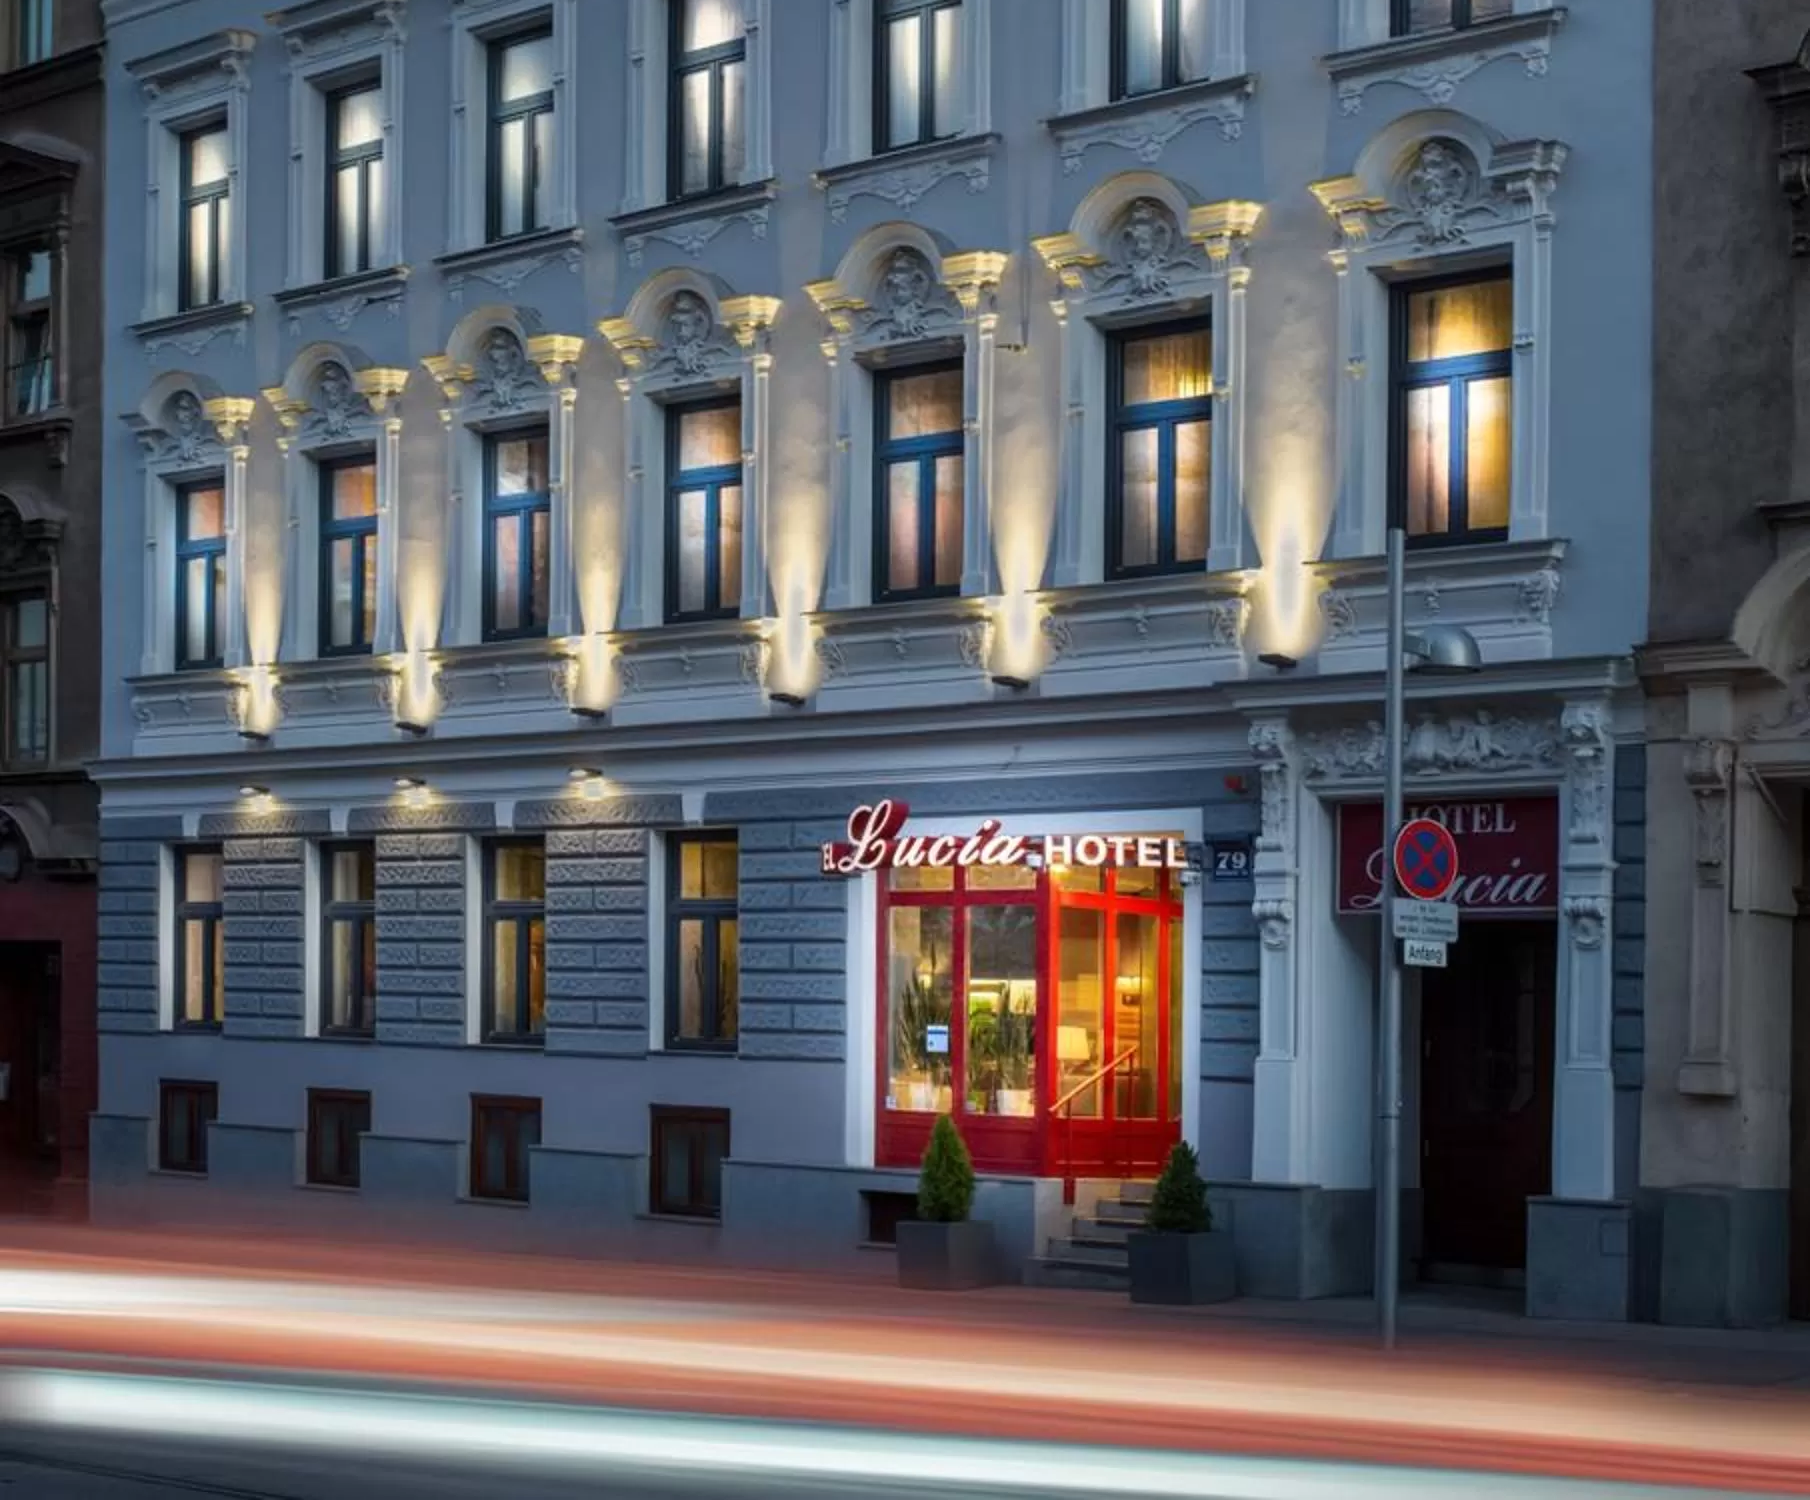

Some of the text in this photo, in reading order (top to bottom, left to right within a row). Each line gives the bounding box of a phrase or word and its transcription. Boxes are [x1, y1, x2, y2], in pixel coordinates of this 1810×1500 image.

[838, 799, 1189, 872] Lucia HOTEL
[1216, 851, 1247, 869] 79
